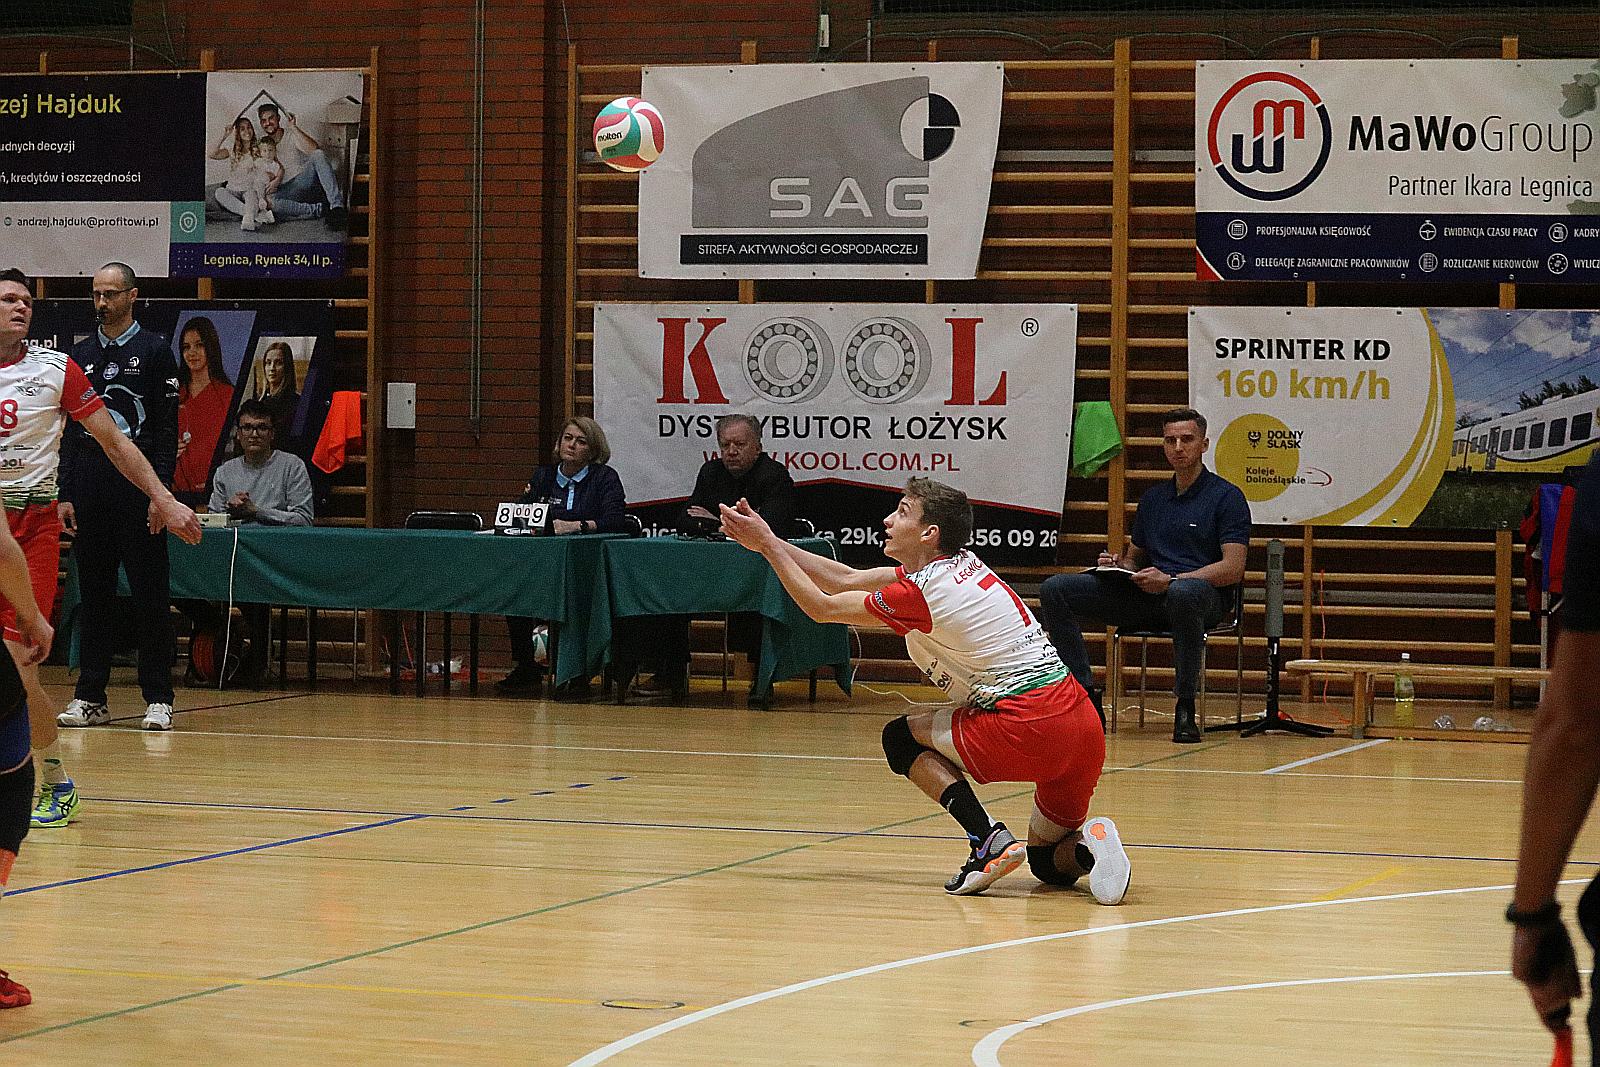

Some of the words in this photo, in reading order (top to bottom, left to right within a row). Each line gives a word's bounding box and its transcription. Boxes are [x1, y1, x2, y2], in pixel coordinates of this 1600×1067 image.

[37, 94, 122, 118] Hajduk
[597, 131, 623, 142] molten
[1348, 115, 1593, 162] MaWoGroup
[37, 141, 75, 153] decyzji
[10, 172, 58, 185] kredytów
[61, 172, 65, 183] i
[66, 172, 141, 185] oszczędności
[1389, 175, 1458, 196] Partner
[1465, 173, 1512, 196] Ikara
[1520, 175, 1593, 202] Legnica
[769, 176, 930, 218] SAG
[17, 216, 159, 229] andrzej.hajduk@profitowi.pl
[1256, 226, 1317, 237] PROFESJONALNA
[1319, 225, 1372, 238] KSIĘGOWOŚĆ
[1443, 227, 1485, 239] EWIDENCJA
[1486, 227, 1511, 237] CZASU
[1513, 227, 1538, 238] PRACY
[1573, 228, 1600, 238] KADRY
[698, 244, 736, 255] STREFA
[738, 241, 818, 256] AKTYWNOŚCI
[820, 243, 919, 256] GOSPODARCZEJ
[204, 254, 253, 268] Legnica,
[255, 254, 291, 268] Rynek
[293, 254, 311, 267] 34,
[322, 258, 334, 268] p.
[1255, 257, 1295, 268] DELEGACJE
[1297, 257, 1349, 268] ZAGRANICZNE
[1443, 259, 1491, 269] ROZLICZANIE
[1492, 257, 1540, 269] KIEROWCÓW
[1215, 337, 1345, 361] SPRINTER
[1353, 338, 1391, 361] KD
[1216, 369, 1278, 398] 160
[1289, 369, 1391, 400] km/h
[658, 414, 871, 440] DYSYBUTOR
[887, 411, 1007, 440] ŁOŻYSK
[1267, 430, 1304, 439] DOLNY
[1246, 466, 1275, 478] Koleje
[1246, 475, 1306, 485] Dolnośląskie
[499, 507, 510, 523] 8
[531, 507, 544, 523] 9
[840, 526, 884, 548] 29k,
[1007, 529, 1035, 547] 09
[1039, 529, 1057, 547] 26
[977, 572, 1032, 628] 7
